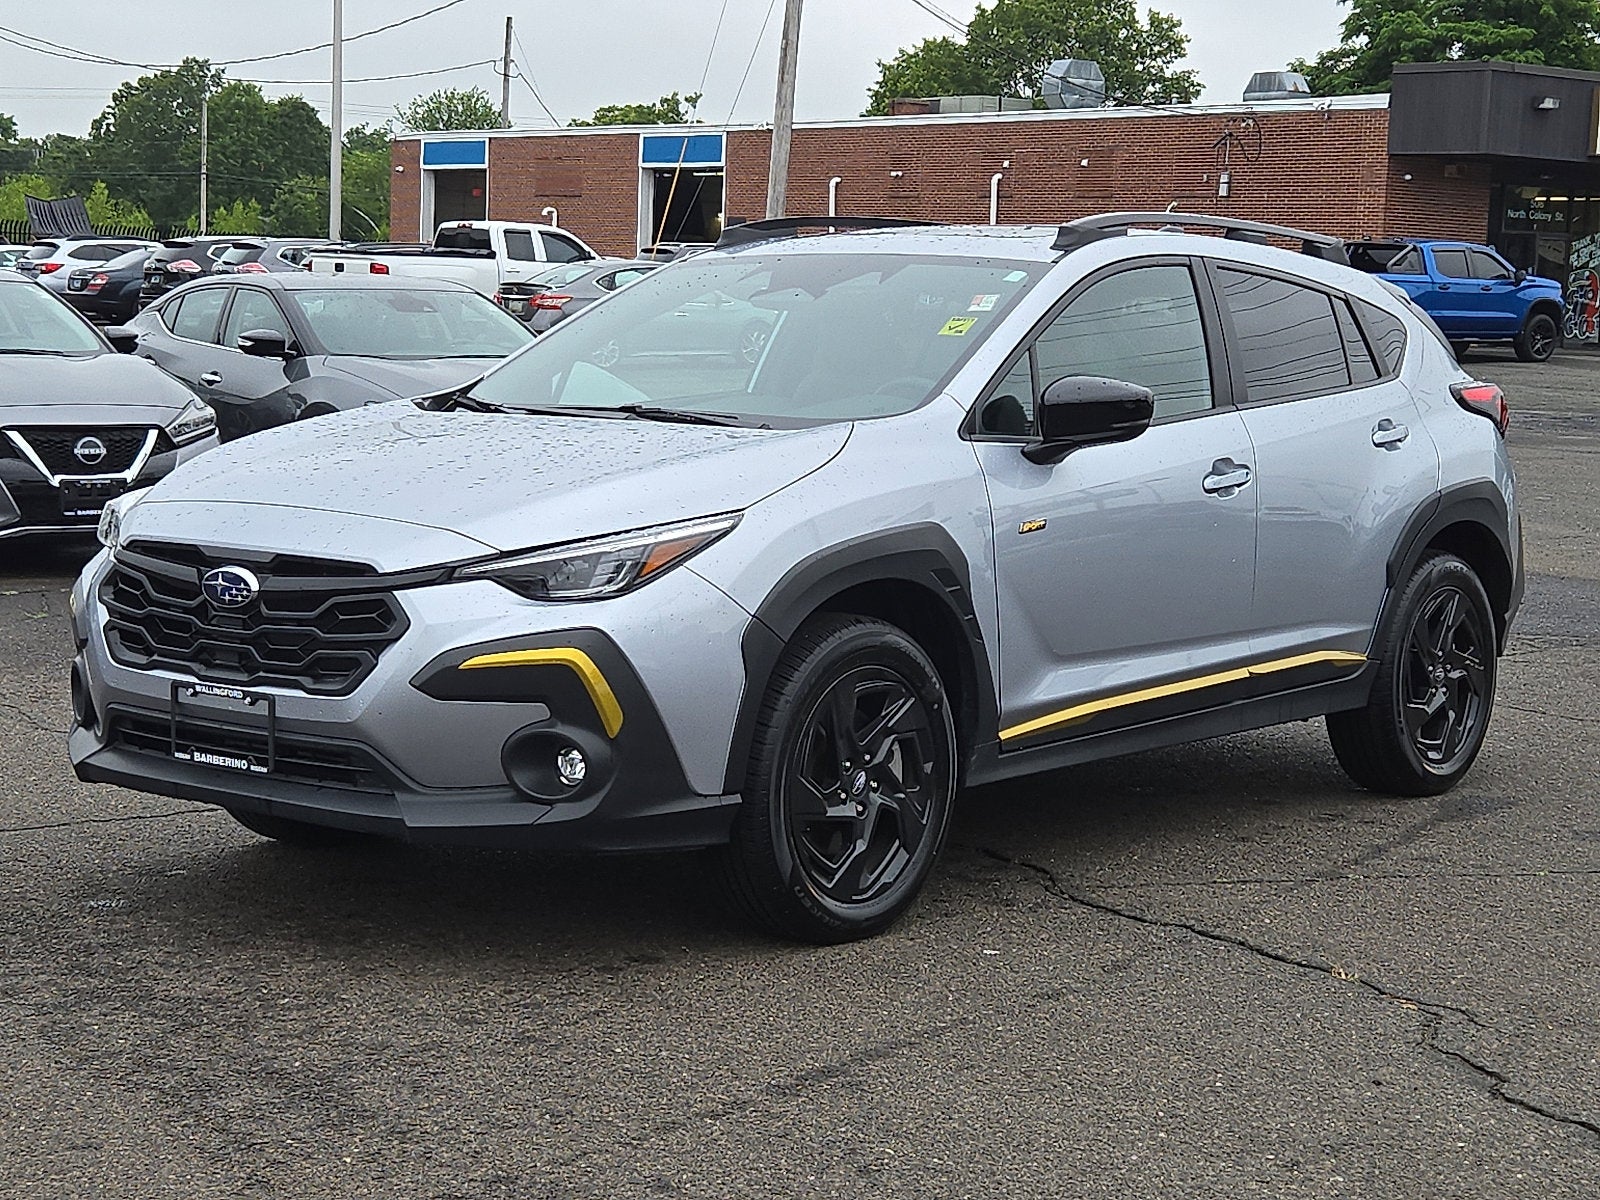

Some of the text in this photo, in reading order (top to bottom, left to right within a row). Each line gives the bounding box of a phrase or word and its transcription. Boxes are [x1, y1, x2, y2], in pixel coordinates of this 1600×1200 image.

[1507, 209, 1526, 219] North
[1529, 210, 1552, 222] Colony
[194, 684, 244, 699] WALLINGFORD
[193, 751, 248, 770] BARBERINO
